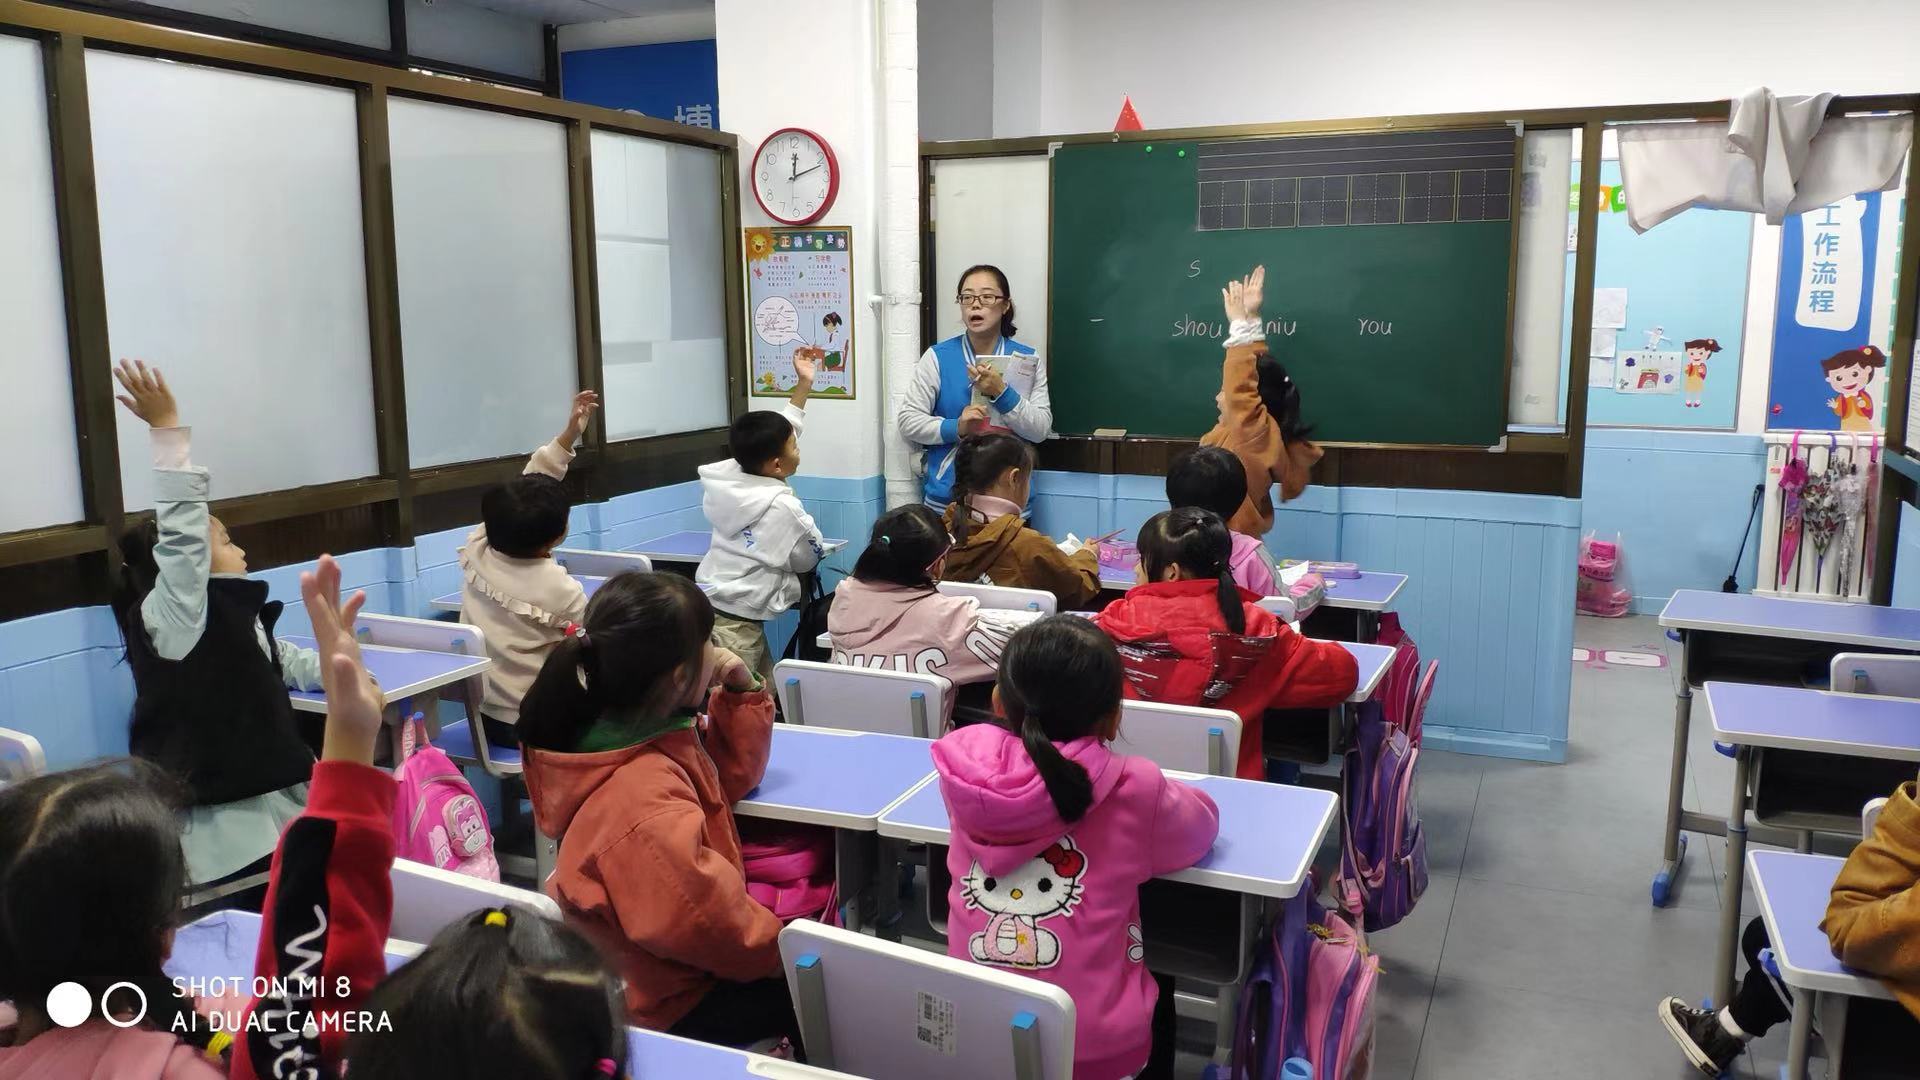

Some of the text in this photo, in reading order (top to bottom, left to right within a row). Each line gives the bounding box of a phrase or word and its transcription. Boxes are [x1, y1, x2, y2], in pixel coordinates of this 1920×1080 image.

[789, 136, 800, 149] 12
[1809, 205, 1841, 313] 工作流程
[1172, 314, 1222, 339] shou
[1266, 316, 1297, 336] niu
